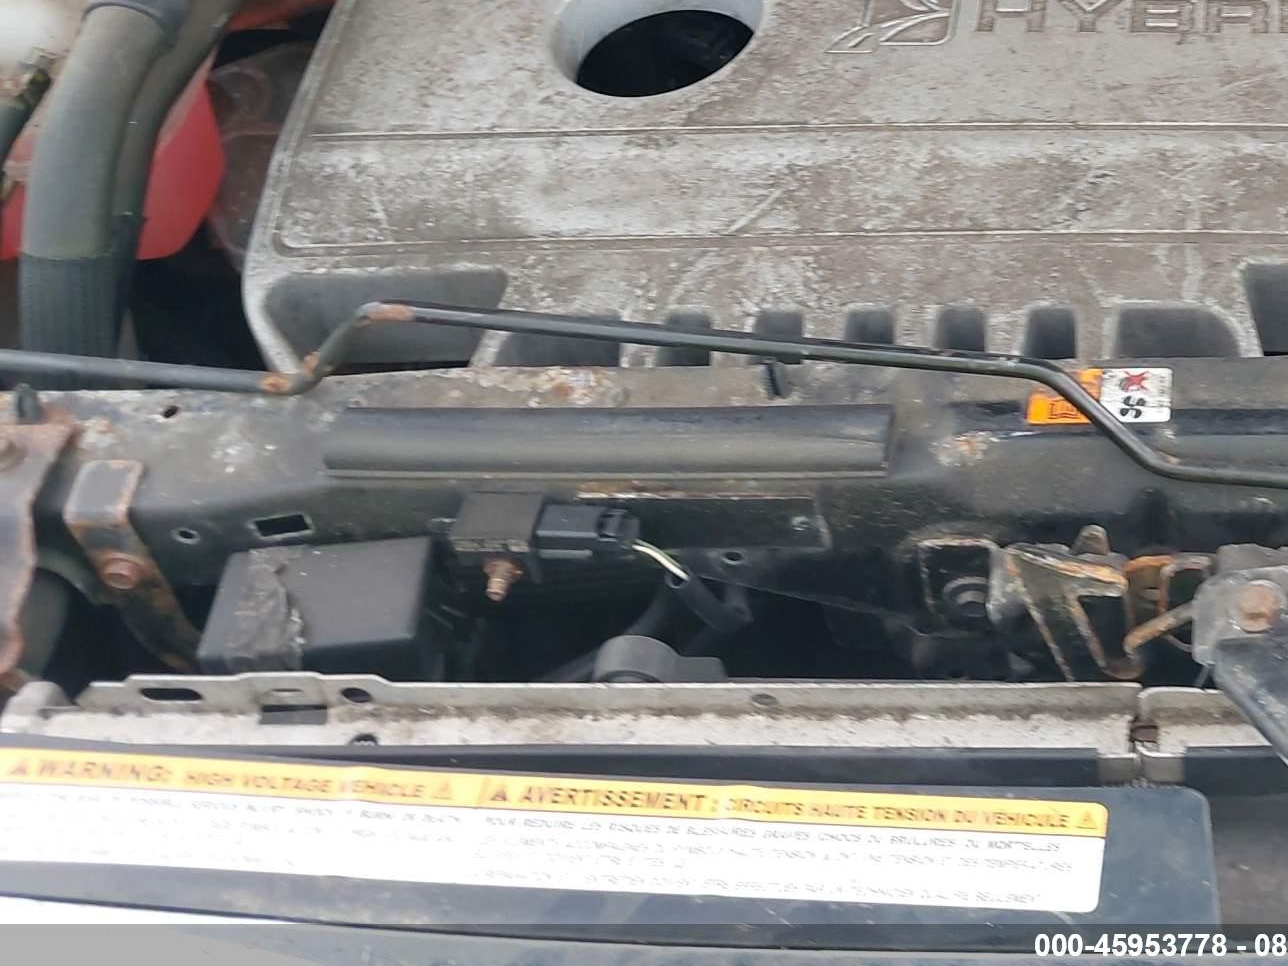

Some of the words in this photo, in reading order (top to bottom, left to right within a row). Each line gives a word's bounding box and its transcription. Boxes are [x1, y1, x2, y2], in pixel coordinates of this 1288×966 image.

[182, 769, 234, 788] HIGH
[240, 772, 333, 794] VOLTAGE
[338, 778, 428, 799] VEHICLE
[725, 796, 805, 818] CIRCUITS
[809, 801, 868, 820] HAUTE
[872, 805, 949, 824] TENSION
[951, 809, 977, 824] DU
